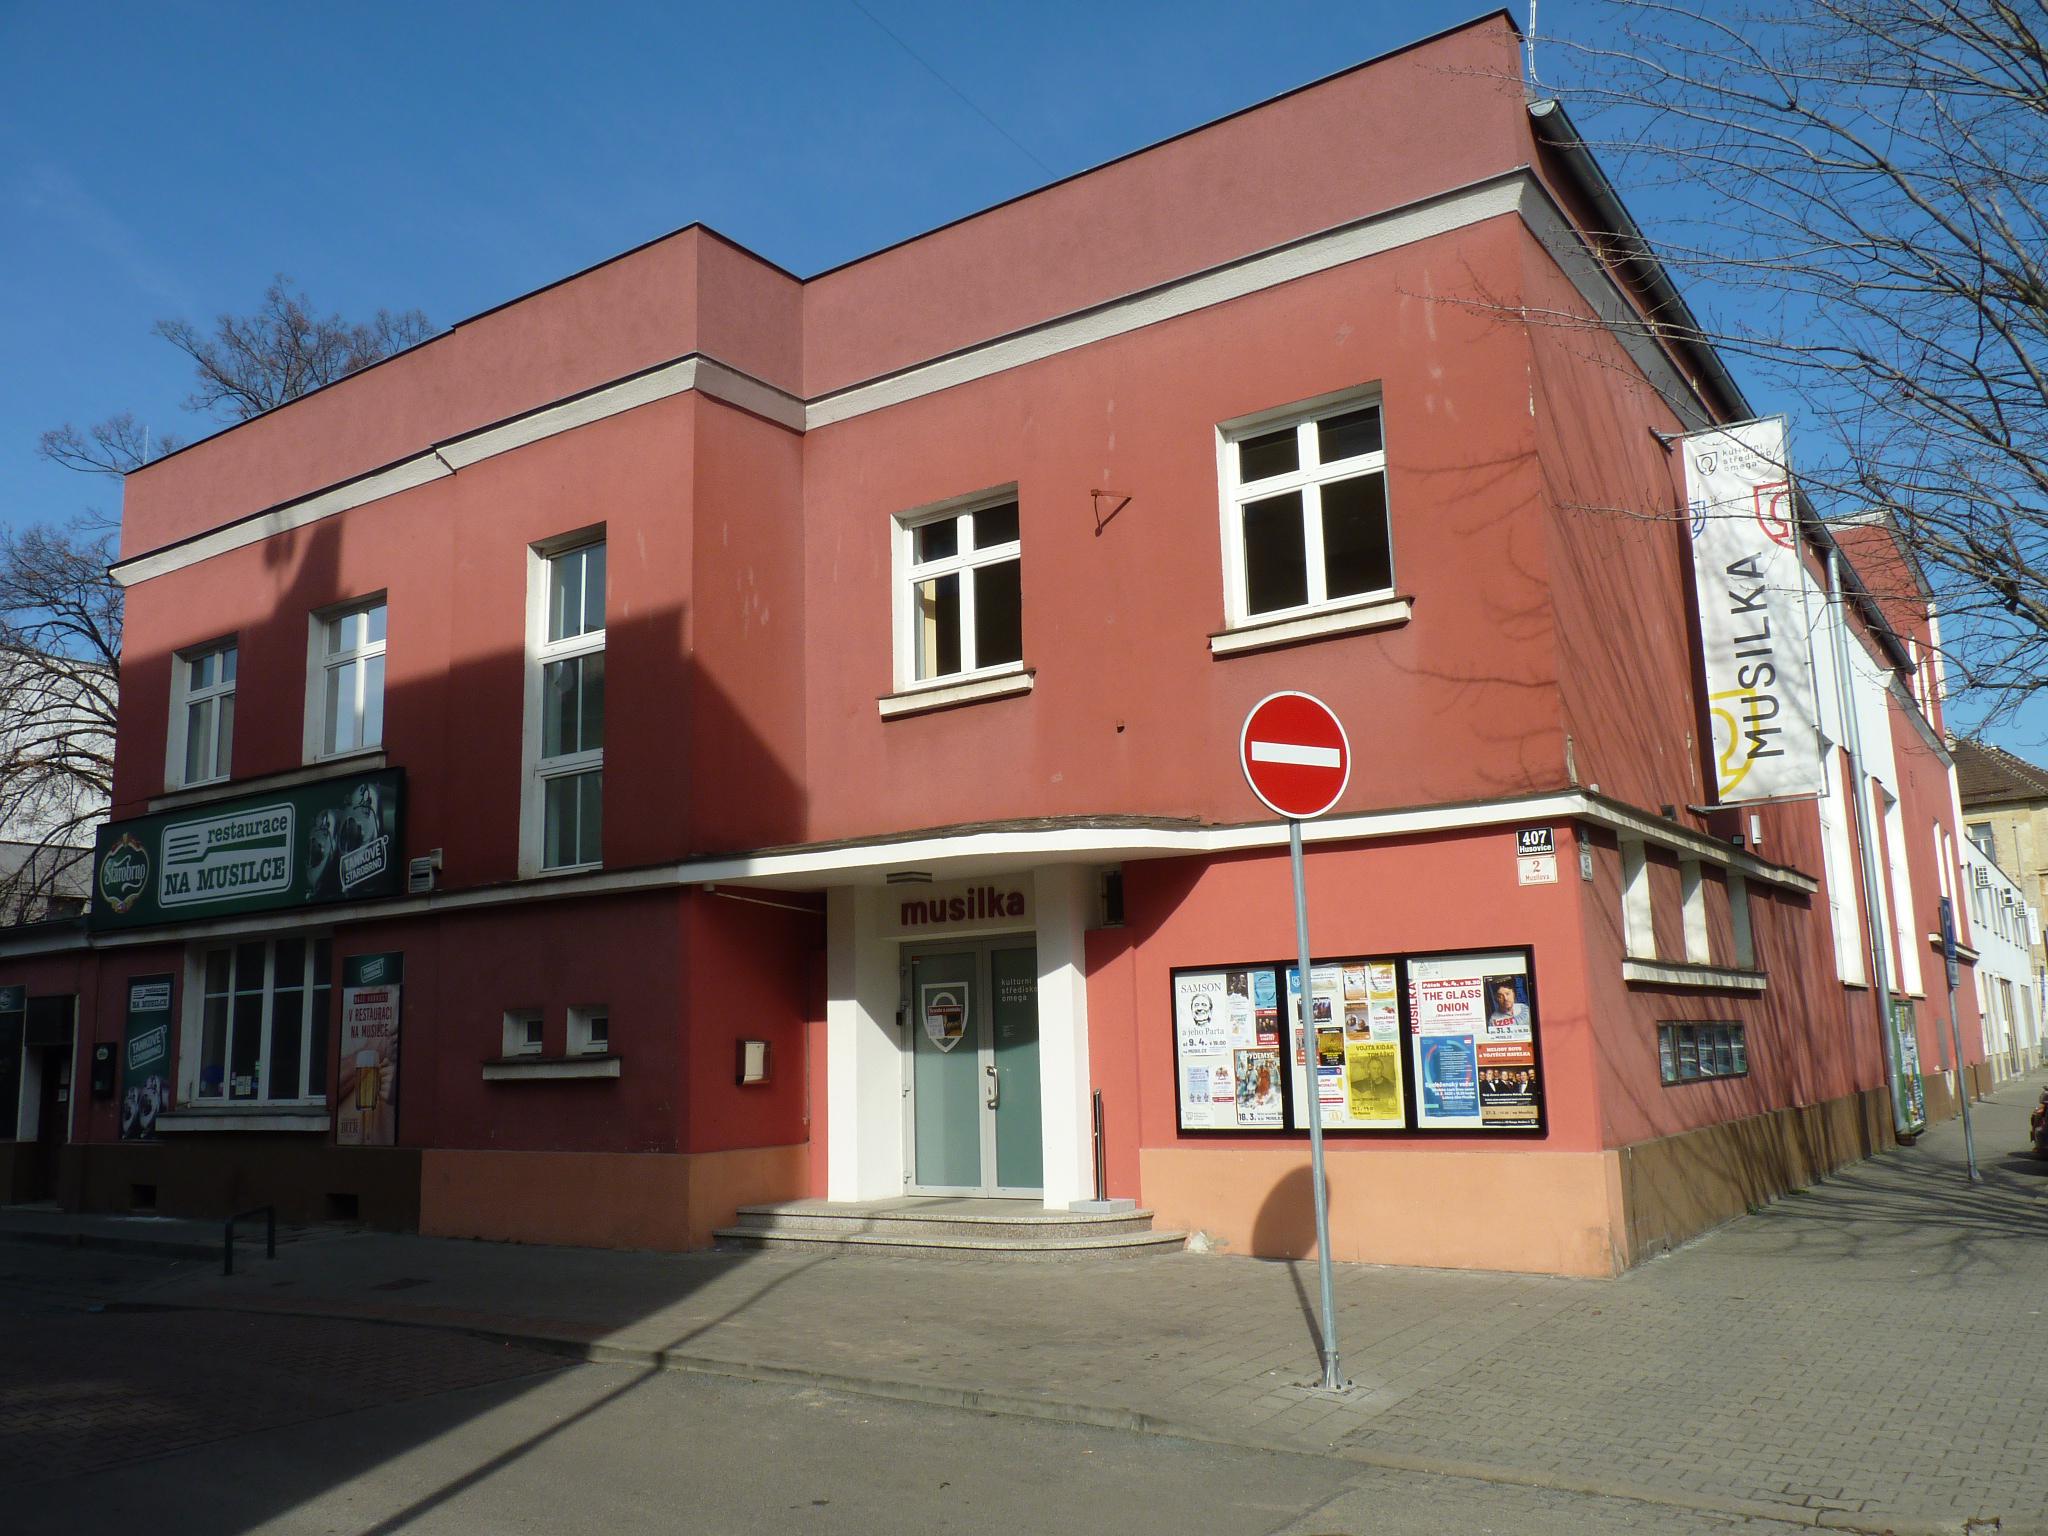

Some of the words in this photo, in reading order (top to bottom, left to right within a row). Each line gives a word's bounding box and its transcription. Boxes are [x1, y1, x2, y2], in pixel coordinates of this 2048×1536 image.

[1724, 461, 1757, 472] omega
[1726, 551, 1785, 760] MUSILKA
[207, 816, 288, 844] restaurace
[1522, 830, 1547, 846] 407
[1520, 844, 1552, 854] Husovice
[344, 839, 382, 874] TANKOVÉ
[345, 856, 382, 884] STAROBRNO
[1533, 860, 1541, 873] 2
[104, 856, 146, 892] Starobrno
[164, 871, 190, 896] NA
[197, 857, 286, 890] MUSILCE
[901, 887, 1025, 926] musilka
[1001, 977, 1032, 986] kulturní
[1181, 982, 1222, 993] SAMSON
[1001, 995, 1027, 1003] omega
[1423, 992, 1444, 1001] THE
[1445, 989, 1482, 1000] GLASS
[1408, 982, 1420, 1035] MUSILKA
[1436, 1002, 1469, 1013] ONION
[1188, 1027, 1204, 1037] jeho
[1205, 1027, 1225, 1036] Parta
[1189, 1038, 1196, 1047] 9.
[1198, 1038, 1207, 1046] 4.
[1249, 1112, 1257, 1121] 3.
